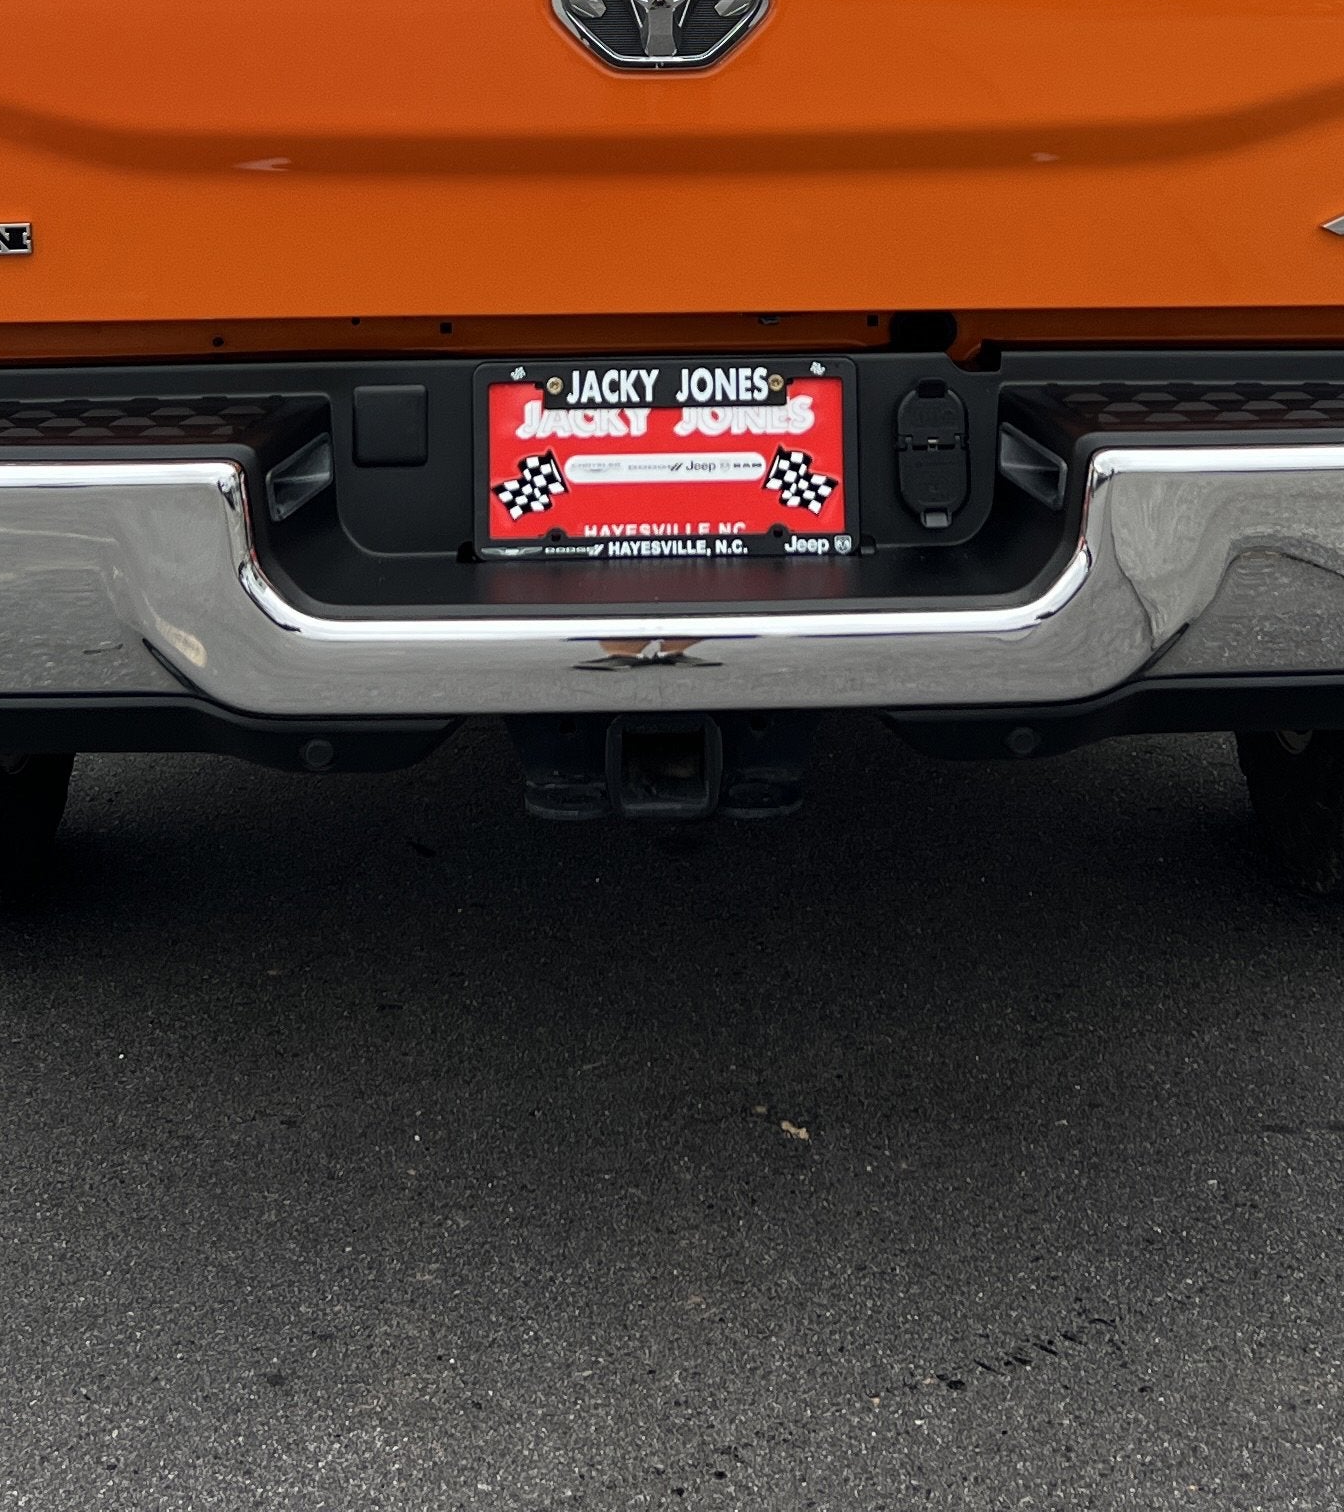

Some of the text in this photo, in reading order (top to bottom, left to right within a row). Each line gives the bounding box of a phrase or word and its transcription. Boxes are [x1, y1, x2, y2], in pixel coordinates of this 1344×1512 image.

[566, 366, 768, 405] JACKY JONES
[516, 395, 814, 439] JACKY JONES
[685, 460, 716, 472] Jeep
[608, 541, 712, 557] HAYESVILLE,
[715, 540, 748, 555] N.C.
[784, 536, 830, 554] Jeep
